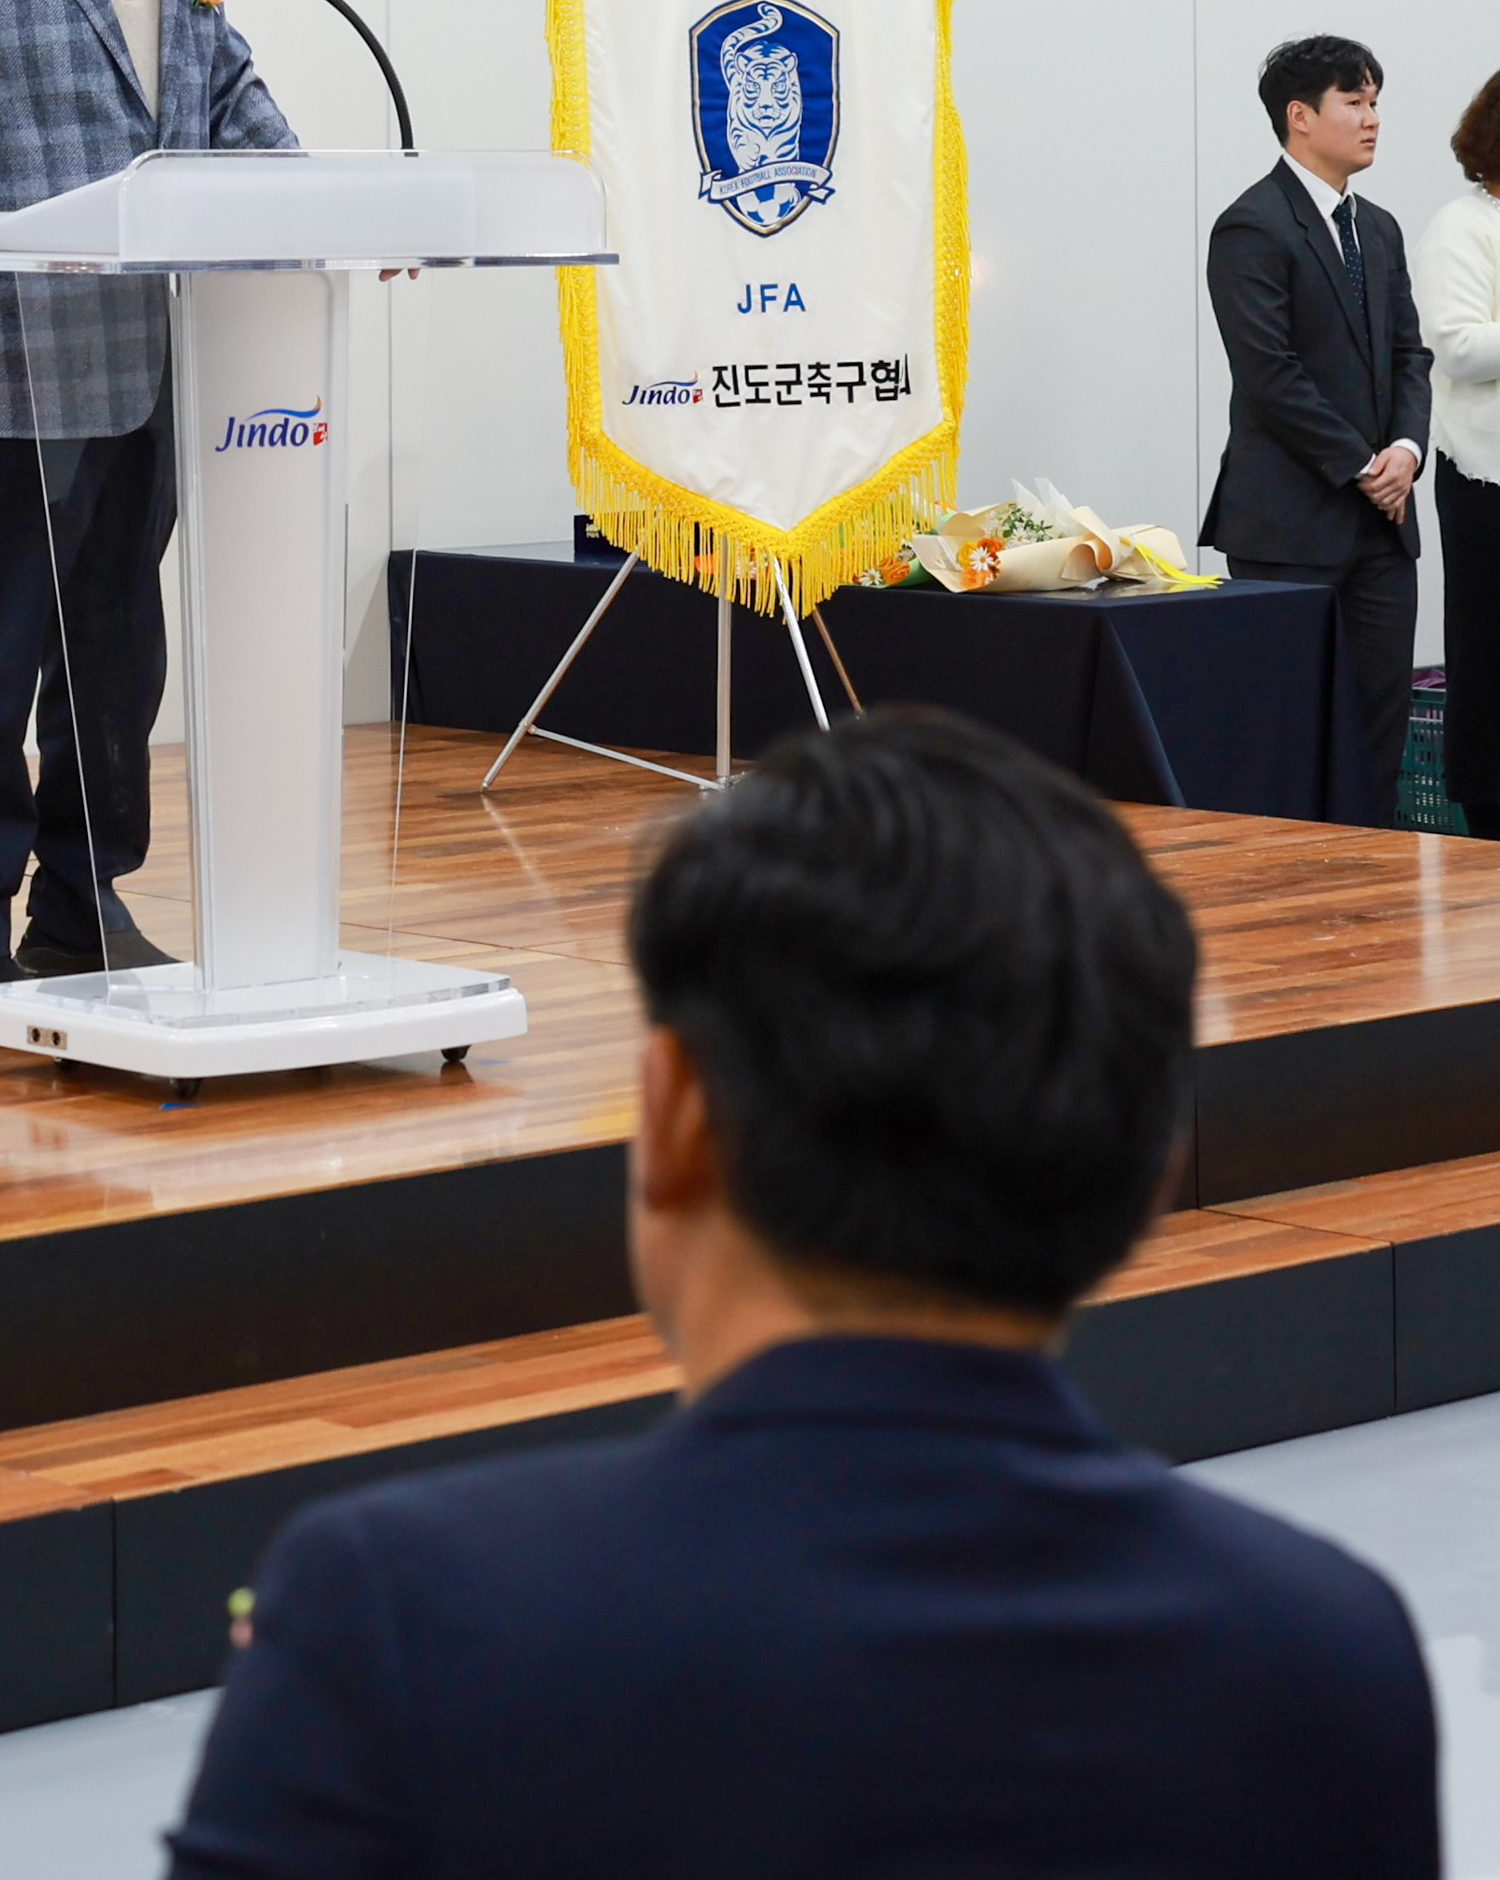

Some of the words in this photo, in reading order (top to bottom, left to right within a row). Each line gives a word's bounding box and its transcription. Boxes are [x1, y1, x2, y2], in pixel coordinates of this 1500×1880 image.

[719, 182, 740, 195] KOREA
[740, 170, 772, 189] FOOTBALL
[774, 165, 818, 179] ASSOCIATION
[736, 282, 807, 314] JFA
[621, 384, 692, 406] Jindo
[214, 416, 310, 453] Jindo
